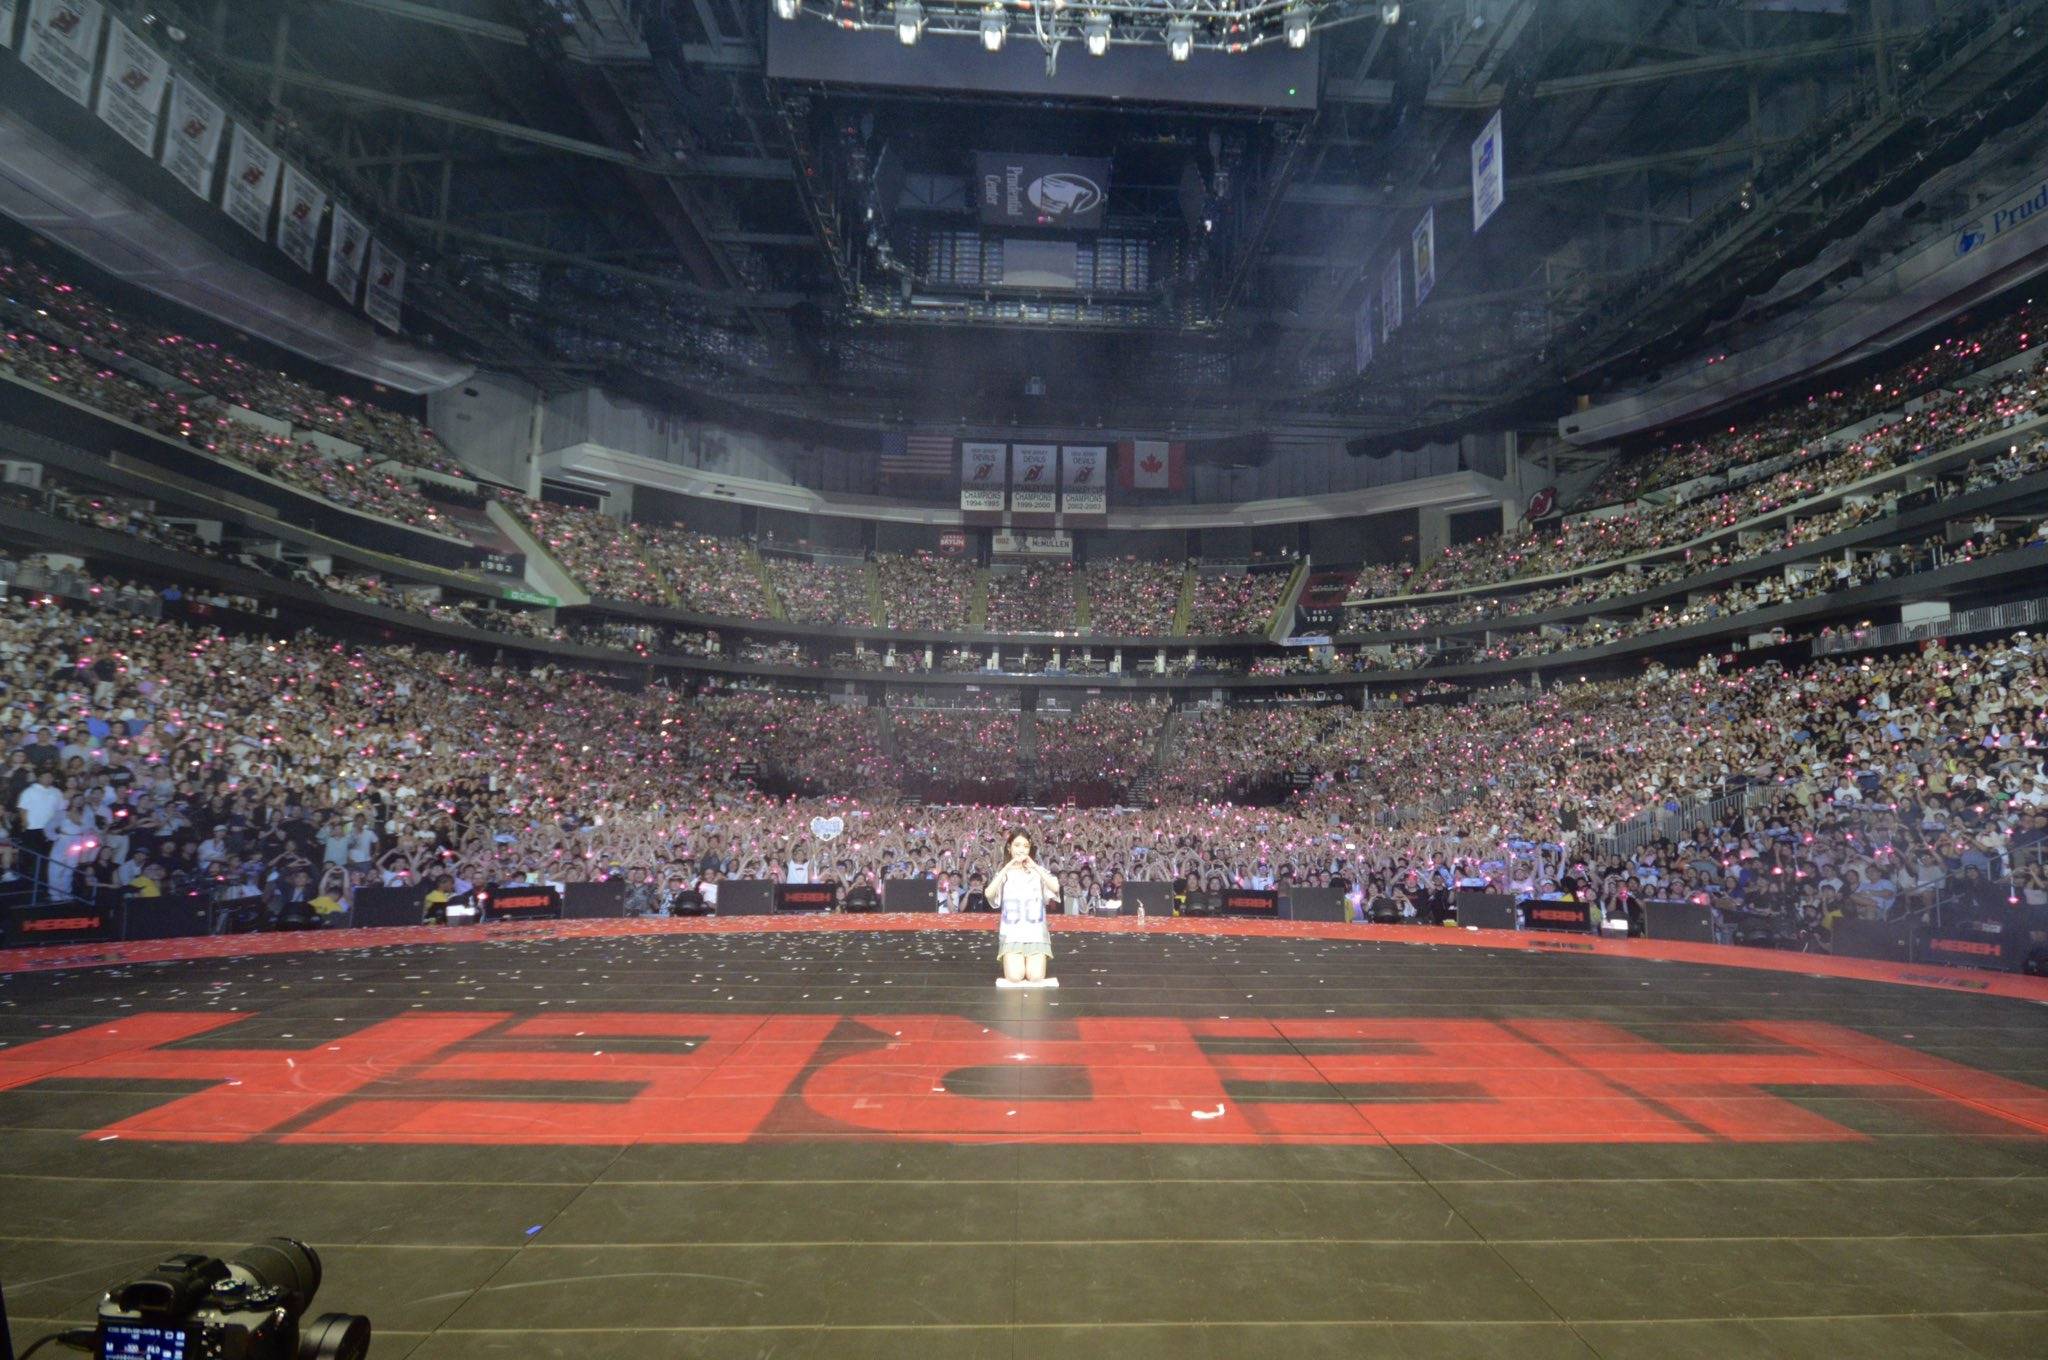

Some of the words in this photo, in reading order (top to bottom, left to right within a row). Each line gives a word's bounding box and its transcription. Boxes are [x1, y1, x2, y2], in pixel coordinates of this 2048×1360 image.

[985, 174, 1001, 205] Center
[1006, 165, 1023, 215] Prudential
[973, 454, 996, 462] DEVILS
[965, 491, 1001, 499] CHAMPIONS
[1015, 493, 1052, 501] CHAMPIONS
[481, 560, 512, 572] 1982
[1532, 910, 1585, 922] HEREH
[1930, 938, 2001, 956] HEREH
